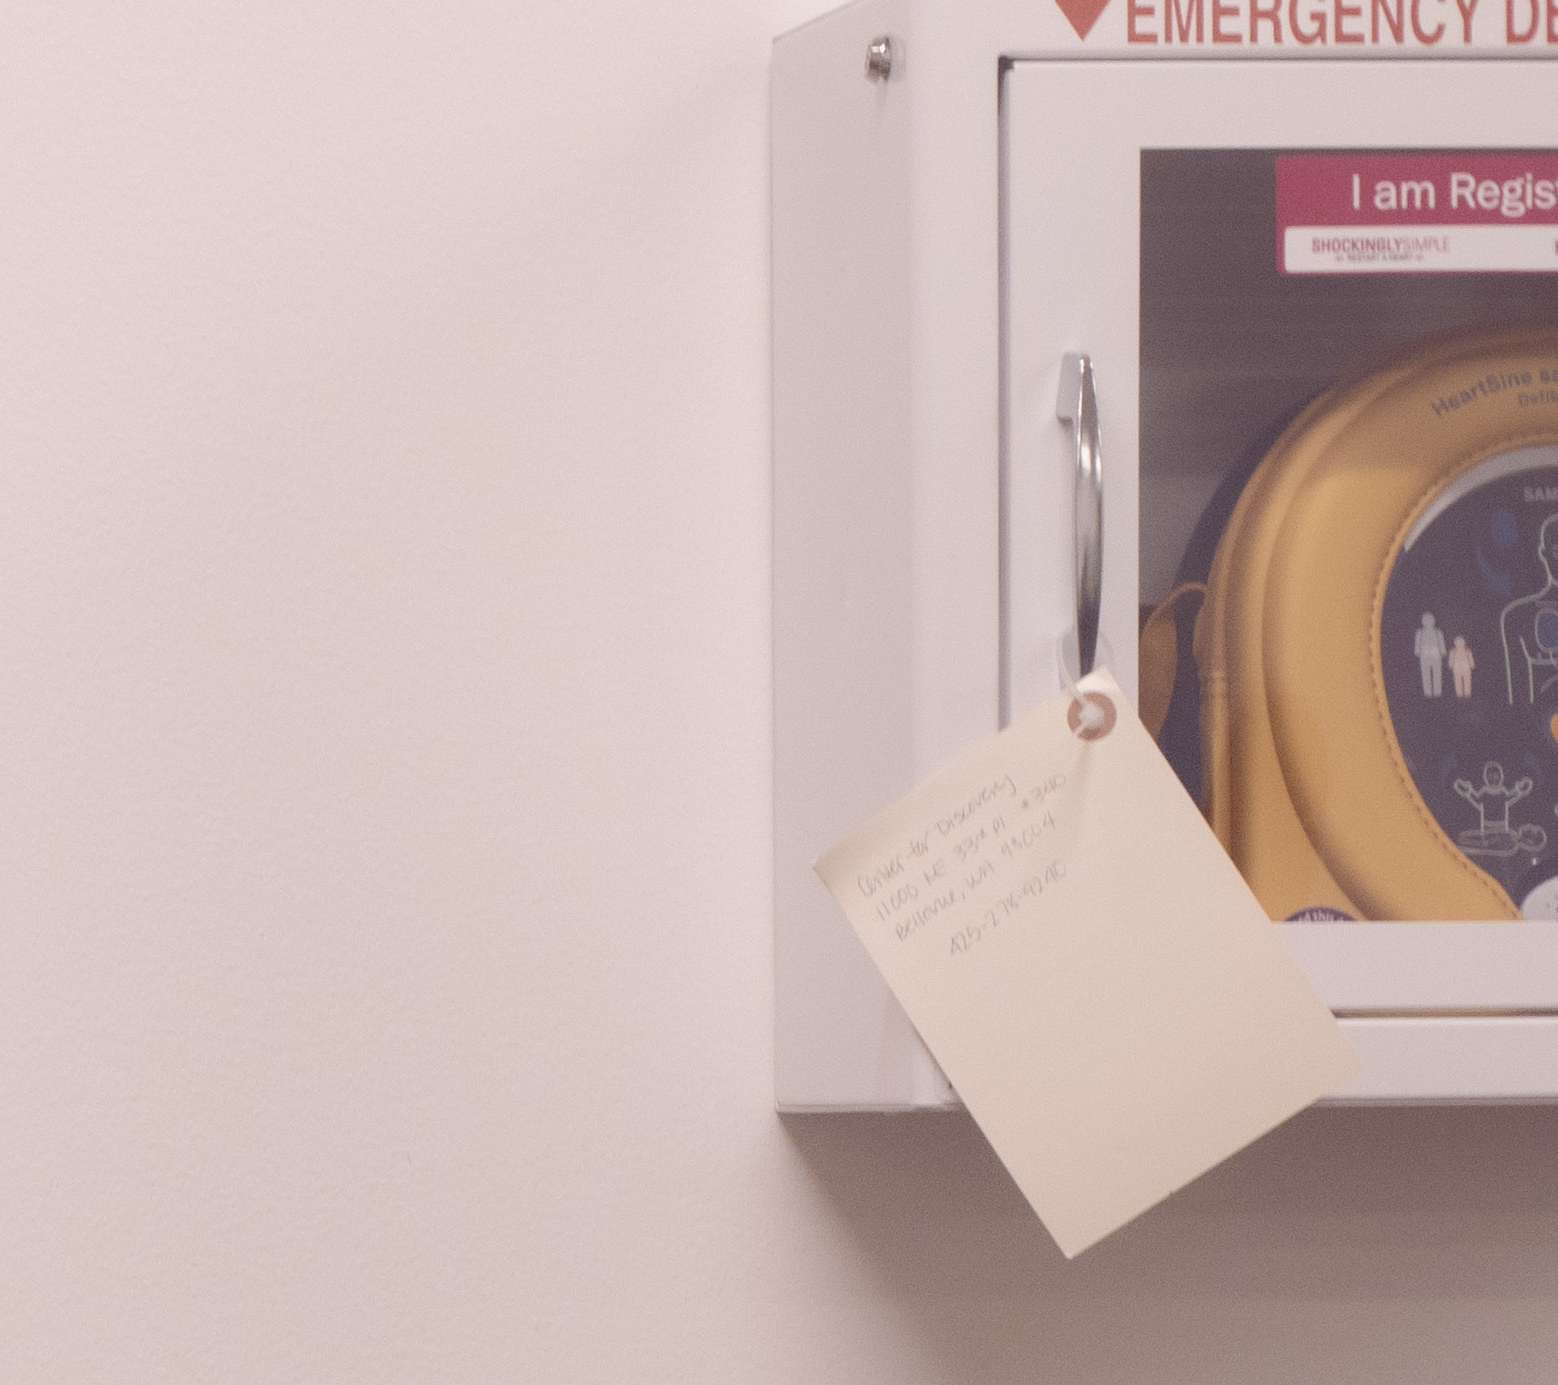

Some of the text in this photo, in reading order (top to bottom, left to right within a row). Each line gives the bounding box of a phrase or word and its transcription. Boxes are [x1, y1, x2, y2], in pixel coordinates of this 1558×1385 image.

[1126, 0, 1476, 45] EMERGENCY
[1352, 173, 1361, 211] I
[1374, 179, 1436, 211] am
[933, 773, 1017, 836] Discovery
